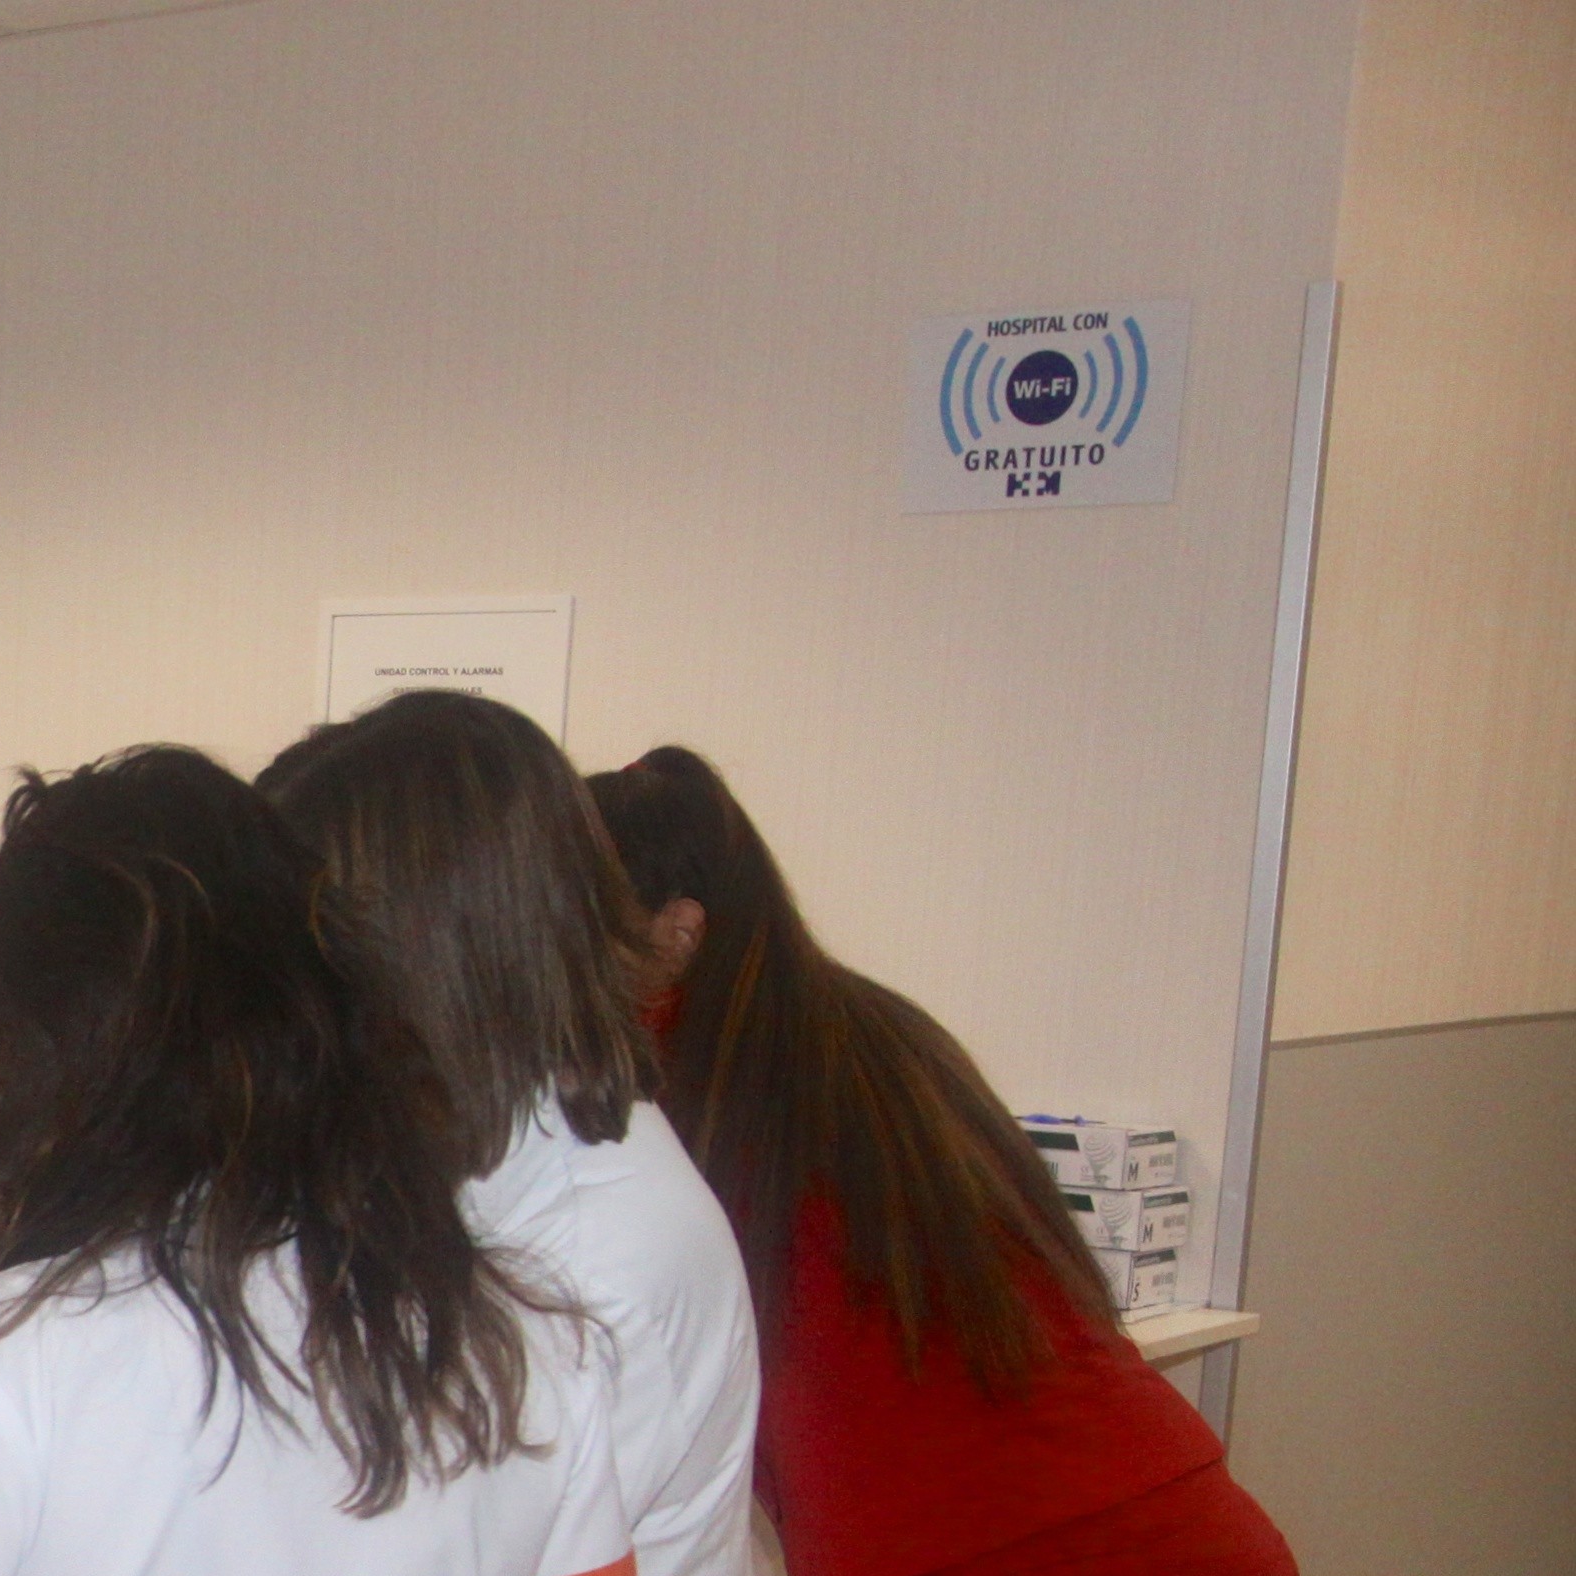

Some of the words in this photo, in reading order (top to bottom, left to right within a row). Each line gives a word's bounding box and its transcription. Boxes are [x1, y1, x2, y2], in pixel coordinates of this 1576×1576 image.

[987, 315, 1067, 337] HOSPITAL
[1072, 312, 1109, 331] CON
[1013, 376, 1072, 400] Wi-Fi
[964, 443, 1105, 472] GRATUITO
[374, 667, 407, 676] UNIDAD
[409, 667, 450, 676] CONTROL
[453, 667, 458, 675] Y
[460, 667, 504, 675] ALARMAS
[1128, 1161, 1139, 1182] M
[1143, 1222, 1154, 1243] M
